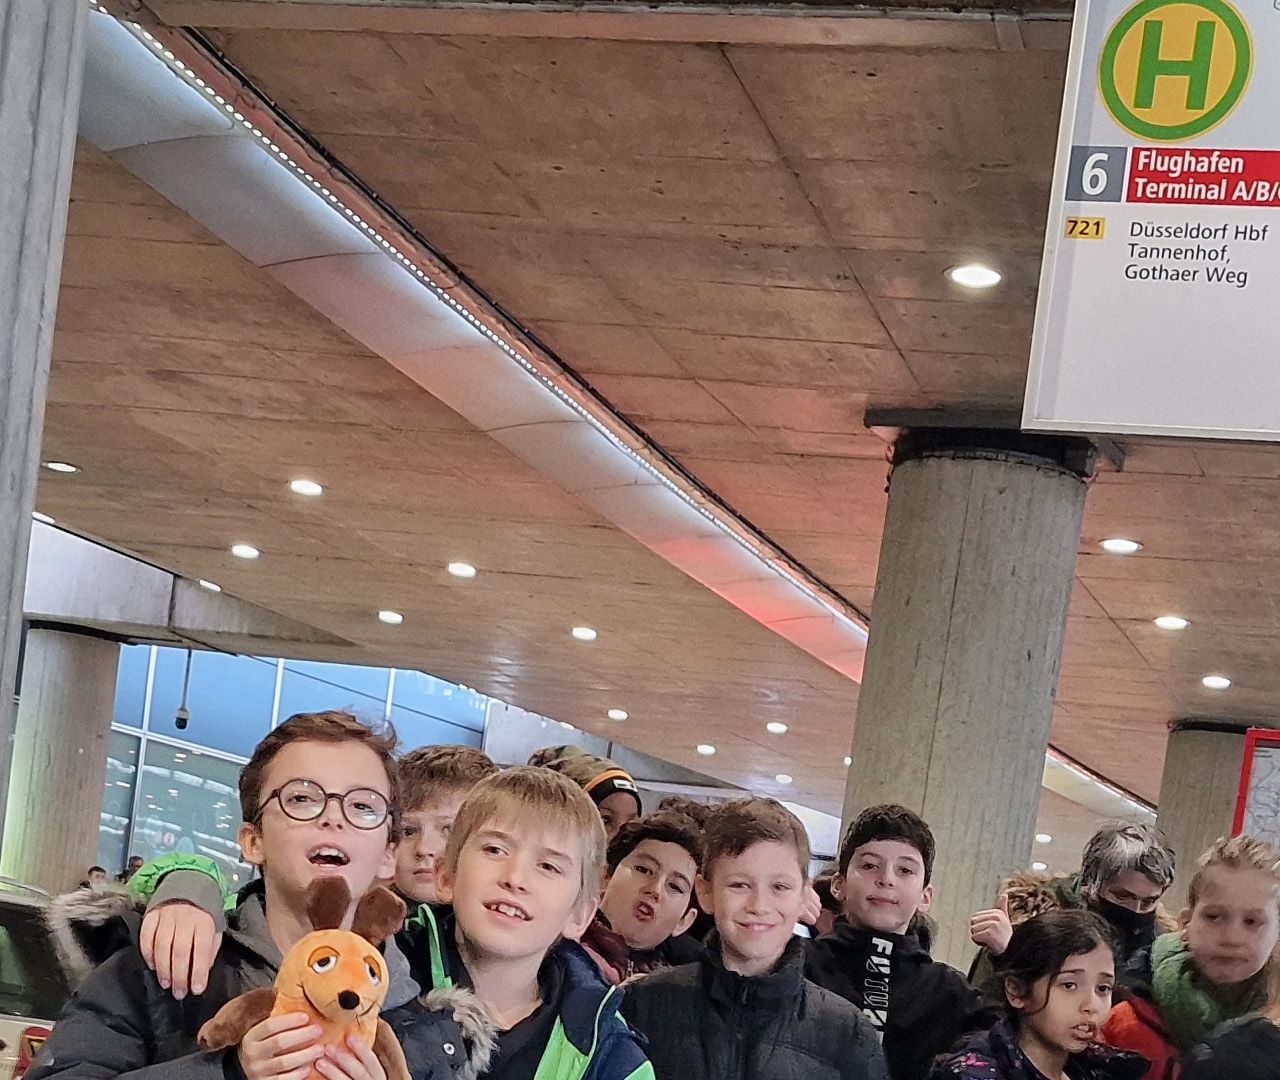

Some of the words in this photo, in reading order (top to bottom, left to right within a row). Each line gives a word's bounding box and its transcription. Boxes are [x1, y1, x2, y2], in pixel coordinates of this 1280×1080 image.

[1133, 19, 1217, 111] H
[1081, 152, 1109, 196] 6
[1137, 150, 1244, 177] Flughafen
[1134, 177, 1227, 200] Terminal
[1067, 219, 1102, 236] 721
[1130, 221, 1229, 240] Düsseldorf
[1234, 224, 1269, 242] Hbf
[1127, 243, 1231, 264] Tannenhof,
[1124, 263, 1200, 282] Gothaer
[1205, 266, 1249, 288] Weg
[863, 936, 894, 1046] FUTUR
